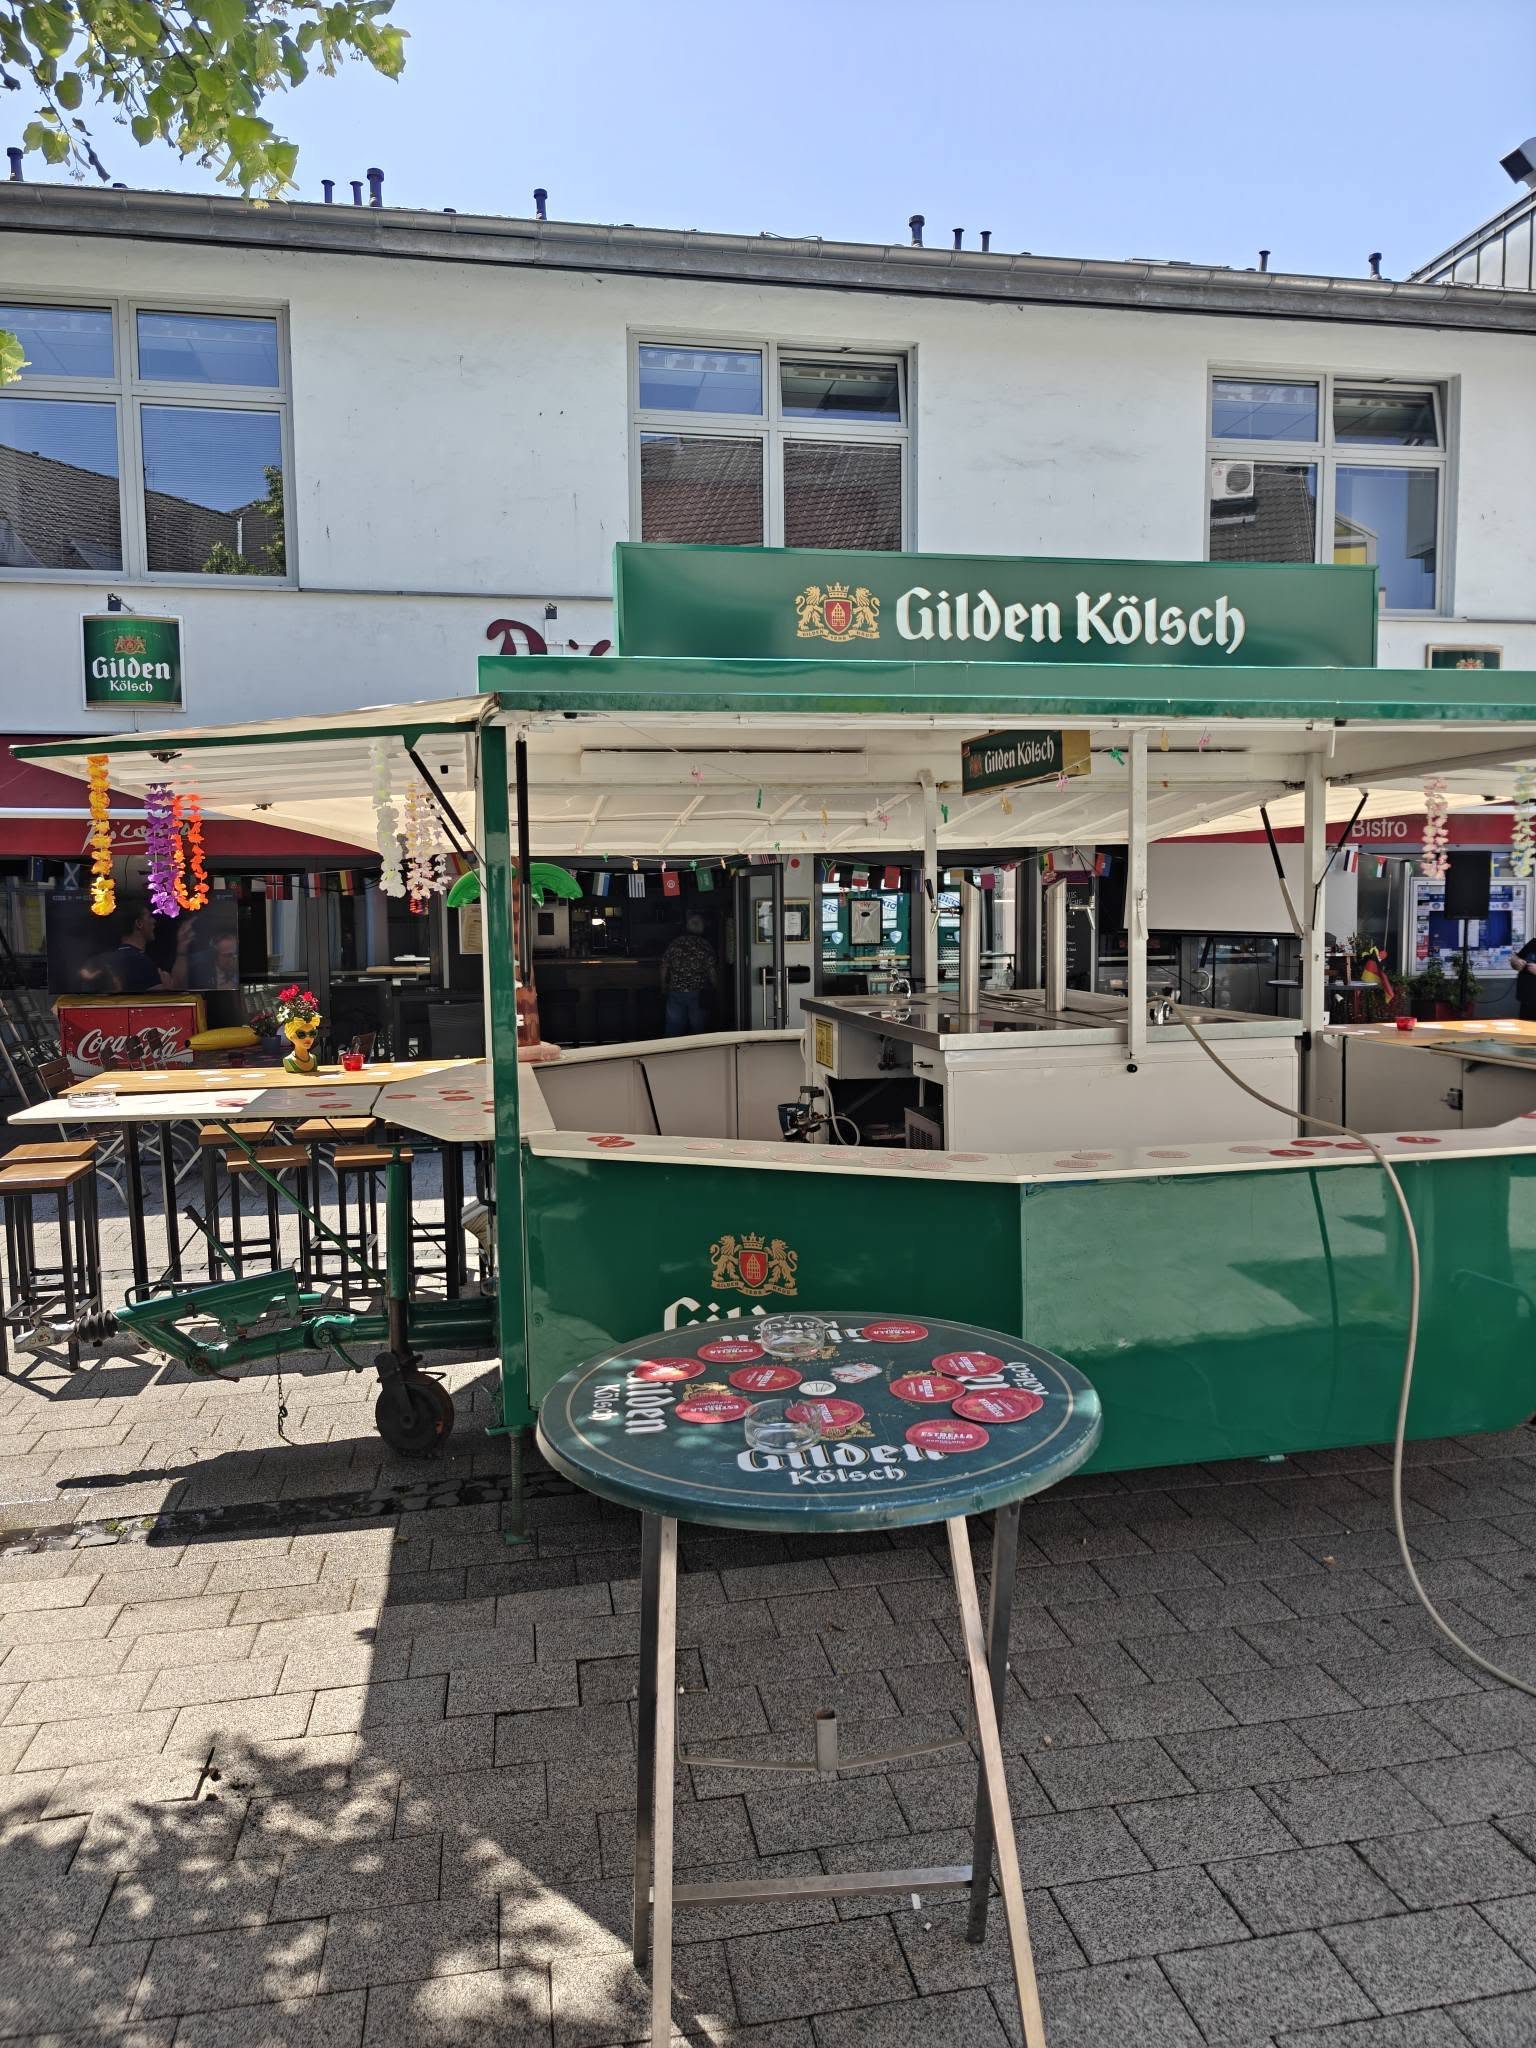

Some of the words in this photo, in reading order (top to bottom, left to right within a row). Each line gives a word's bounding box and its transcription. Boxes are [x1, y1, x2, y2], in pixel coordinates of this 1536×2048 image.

[896, 586, 1063, 644] Gilden
[1075, 591, 1245, 654] Kölsch
[92, 656, 171, 680] Gilden
[109, 680, 153, 694] Kölsch
[984, 748, 1016, 774] Gilden
[1017, 735, 1056, 767] Kölsch
[1352, 818, 1408, 838] Bistro
[588, 1383, 621, 1421] Kölsch
[789, 1465, 907, 1486] Kölsch
